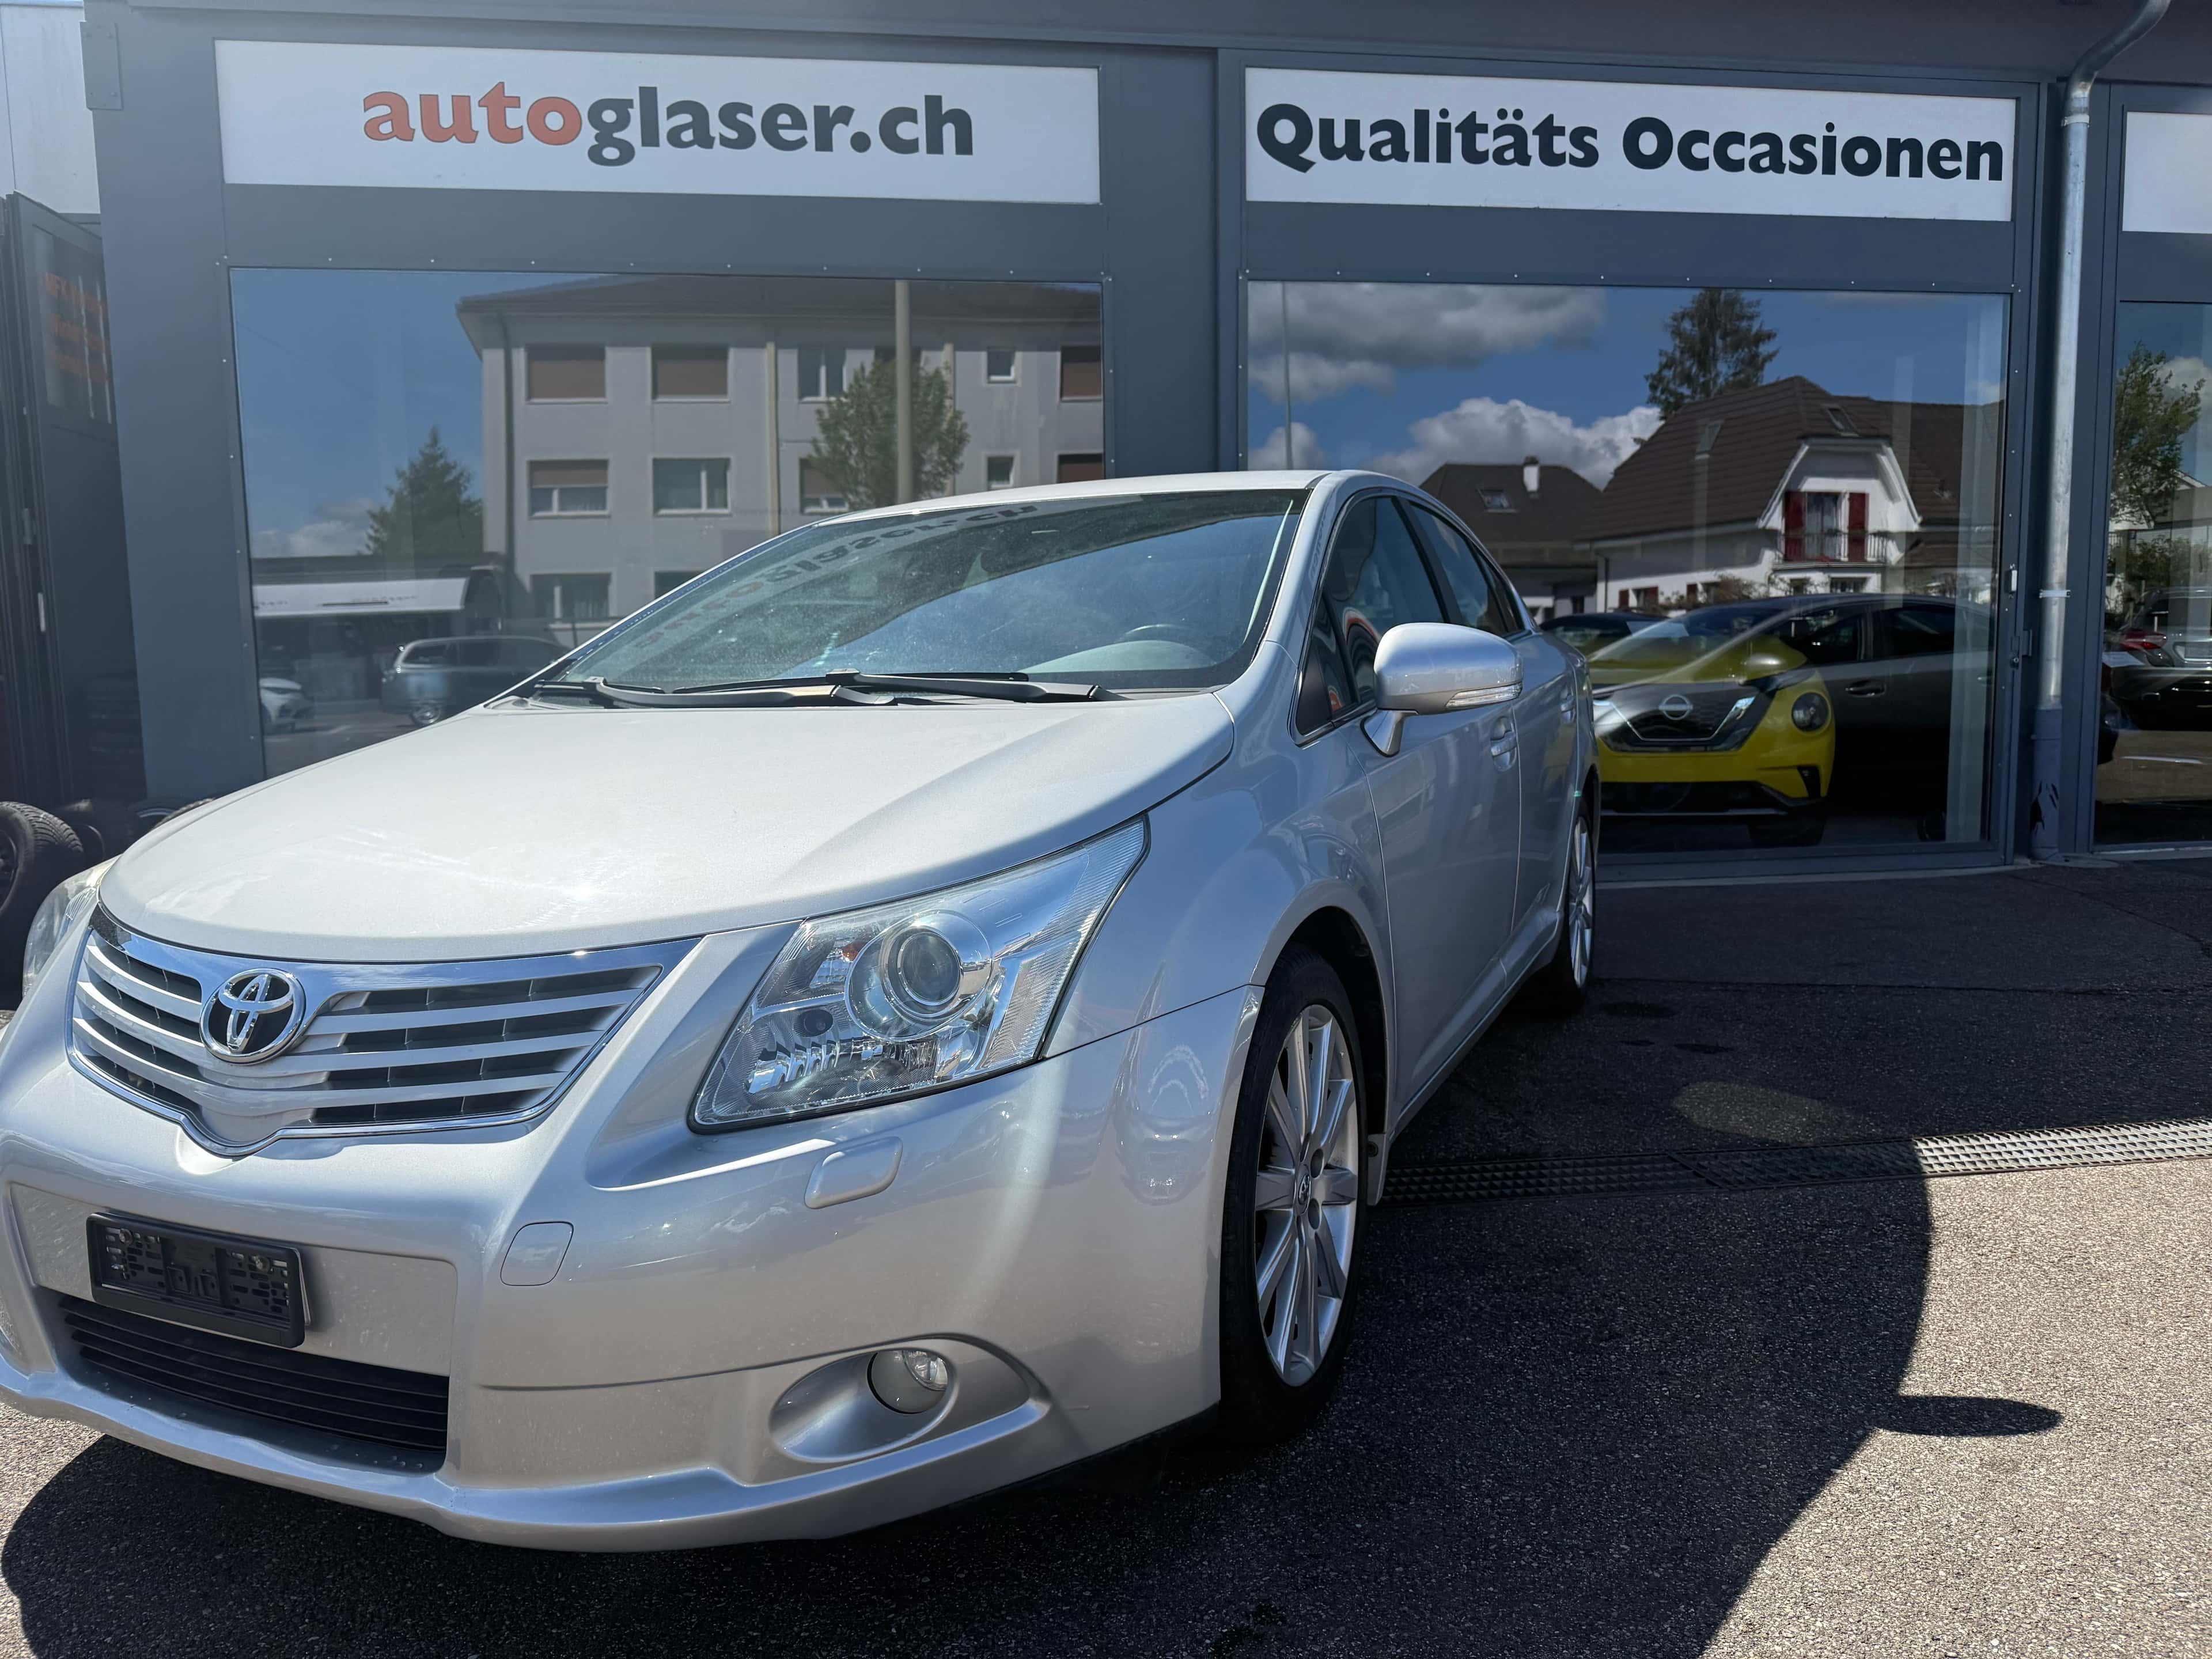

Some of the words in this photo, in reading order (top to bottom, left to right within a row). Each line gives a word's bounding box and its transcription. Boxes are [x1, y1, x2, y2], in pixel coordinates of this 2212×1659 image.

[363, 82, 973, 166] autoglaser.ch
[1256, 103, 1599, 173] Qualitäts
[1622, 117, 2003, 181] Occasionen
